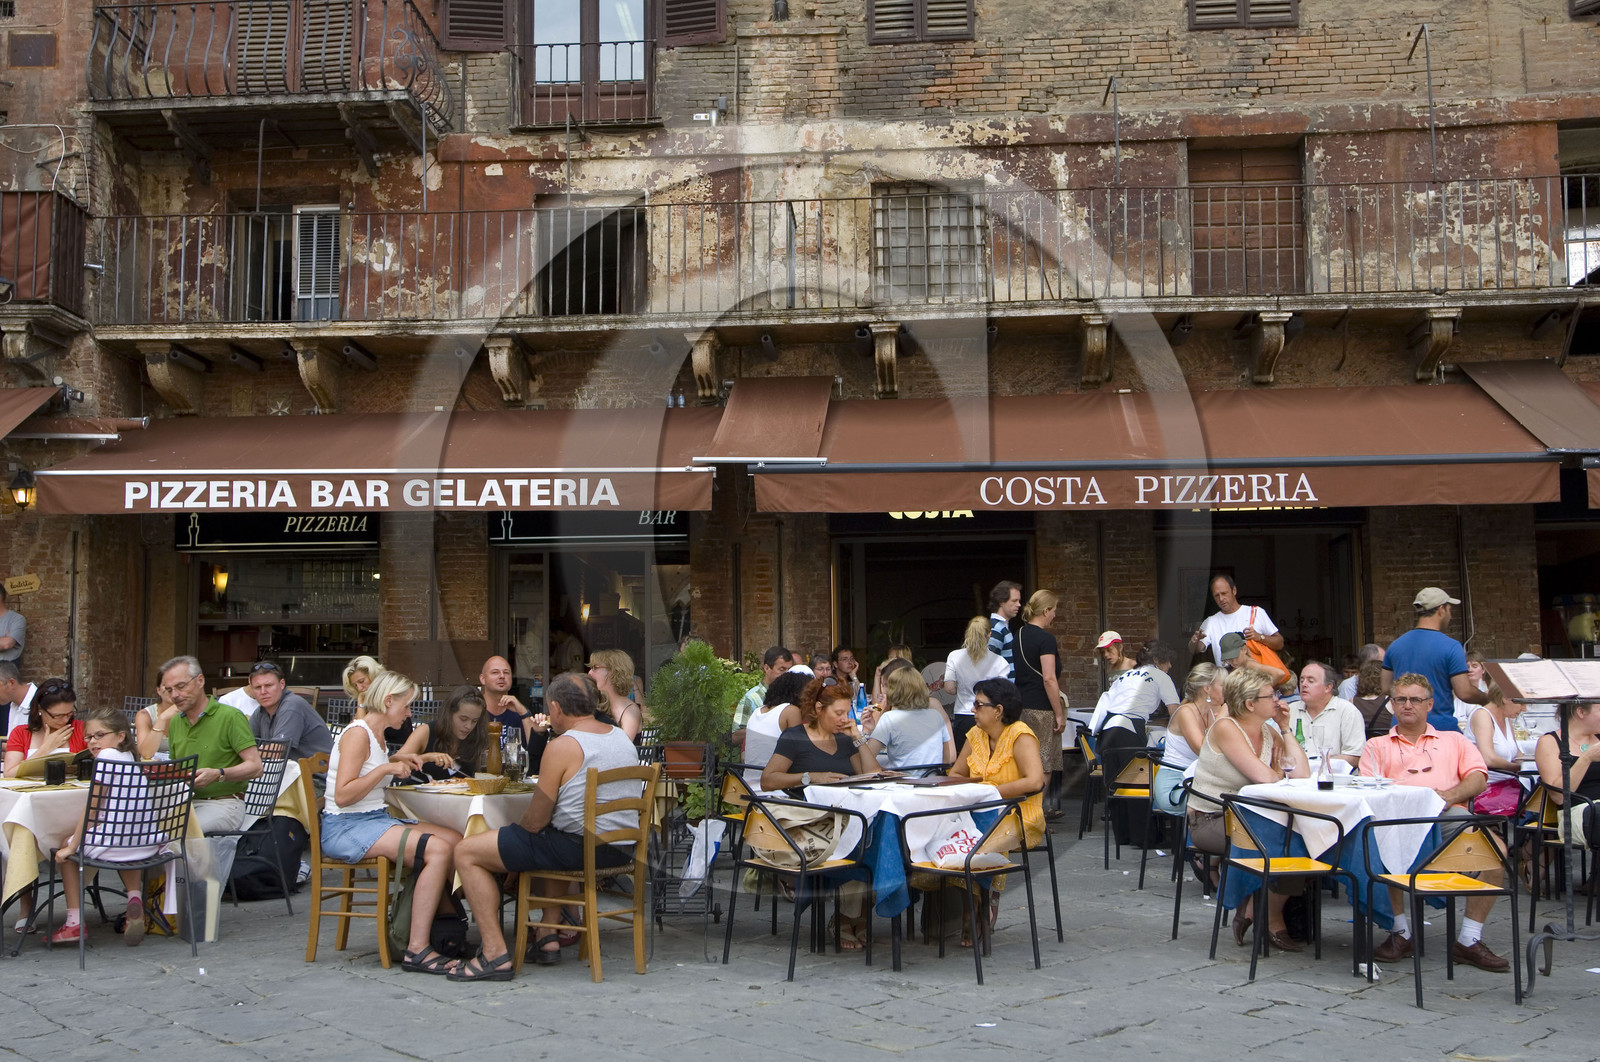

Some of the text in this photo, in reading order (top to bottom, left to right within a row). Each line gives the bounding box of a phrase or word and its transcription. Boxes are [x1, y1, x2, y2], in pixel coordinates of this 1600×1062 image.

[124, 478, 620, 509] PIZZERIA BAR GELATERIA
[980, 473, 1319, 507] COSTA PIZZERIA
[283, 515, 368, 533] PIZZERIA
[638, 510, 677, 525] BAR
